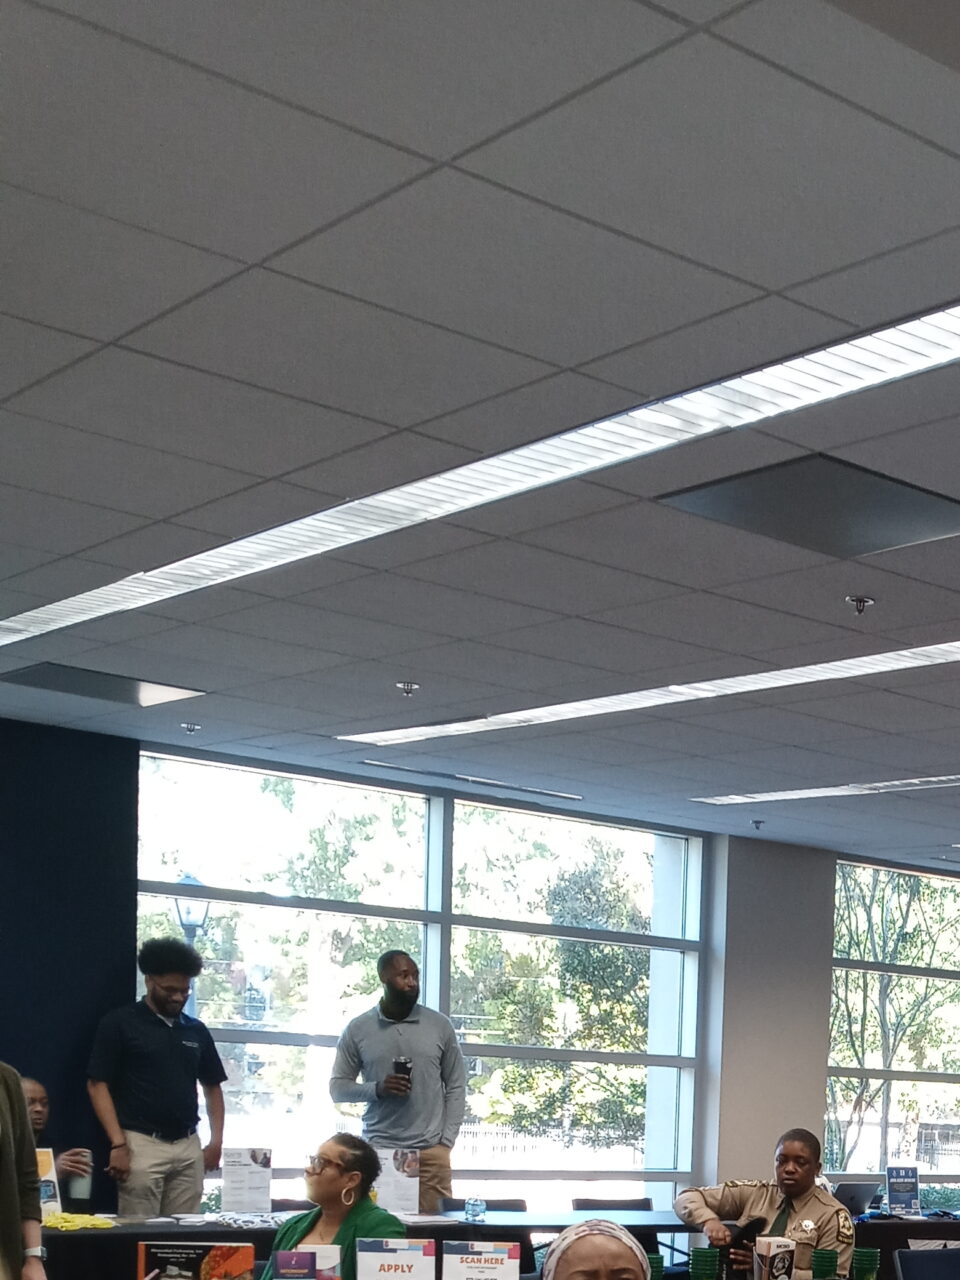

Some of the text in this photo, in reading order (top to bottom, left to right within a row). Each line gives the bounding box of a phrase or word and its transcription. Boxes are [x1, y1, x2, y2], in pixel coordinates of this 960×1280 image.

[459, 1256, 505, 1265] SCAN HERE
[378, 1263, 414, 1274] APPLY
